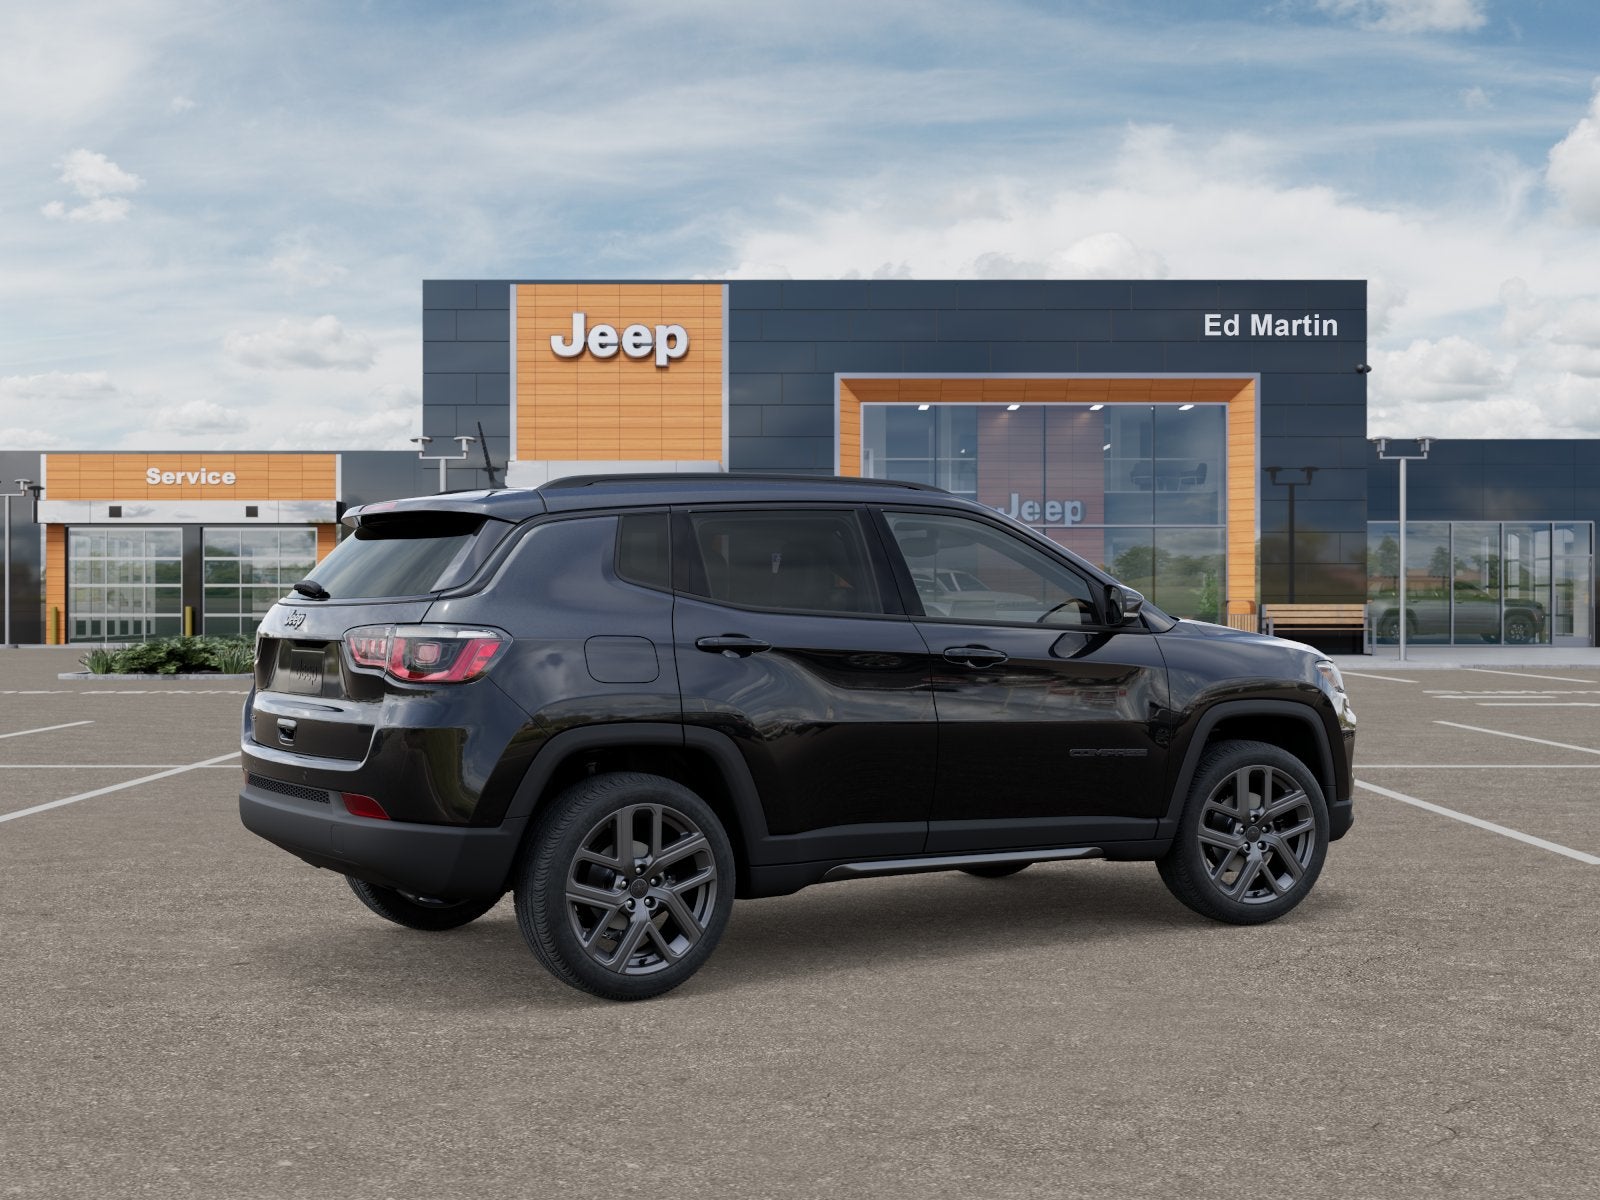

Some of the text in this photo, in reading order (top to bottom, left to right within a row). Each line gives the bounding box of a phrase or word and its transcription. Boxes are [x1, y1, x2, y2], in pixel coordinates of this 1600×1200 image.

[1204, 313, 1338, 336] Ed Martin
[550, 312, 689, 368] Jeep
[146, 467, 236, 485] Service
[995, 493, 1084, 527] Jeep
[284, 609, 307, 630] Jeep
